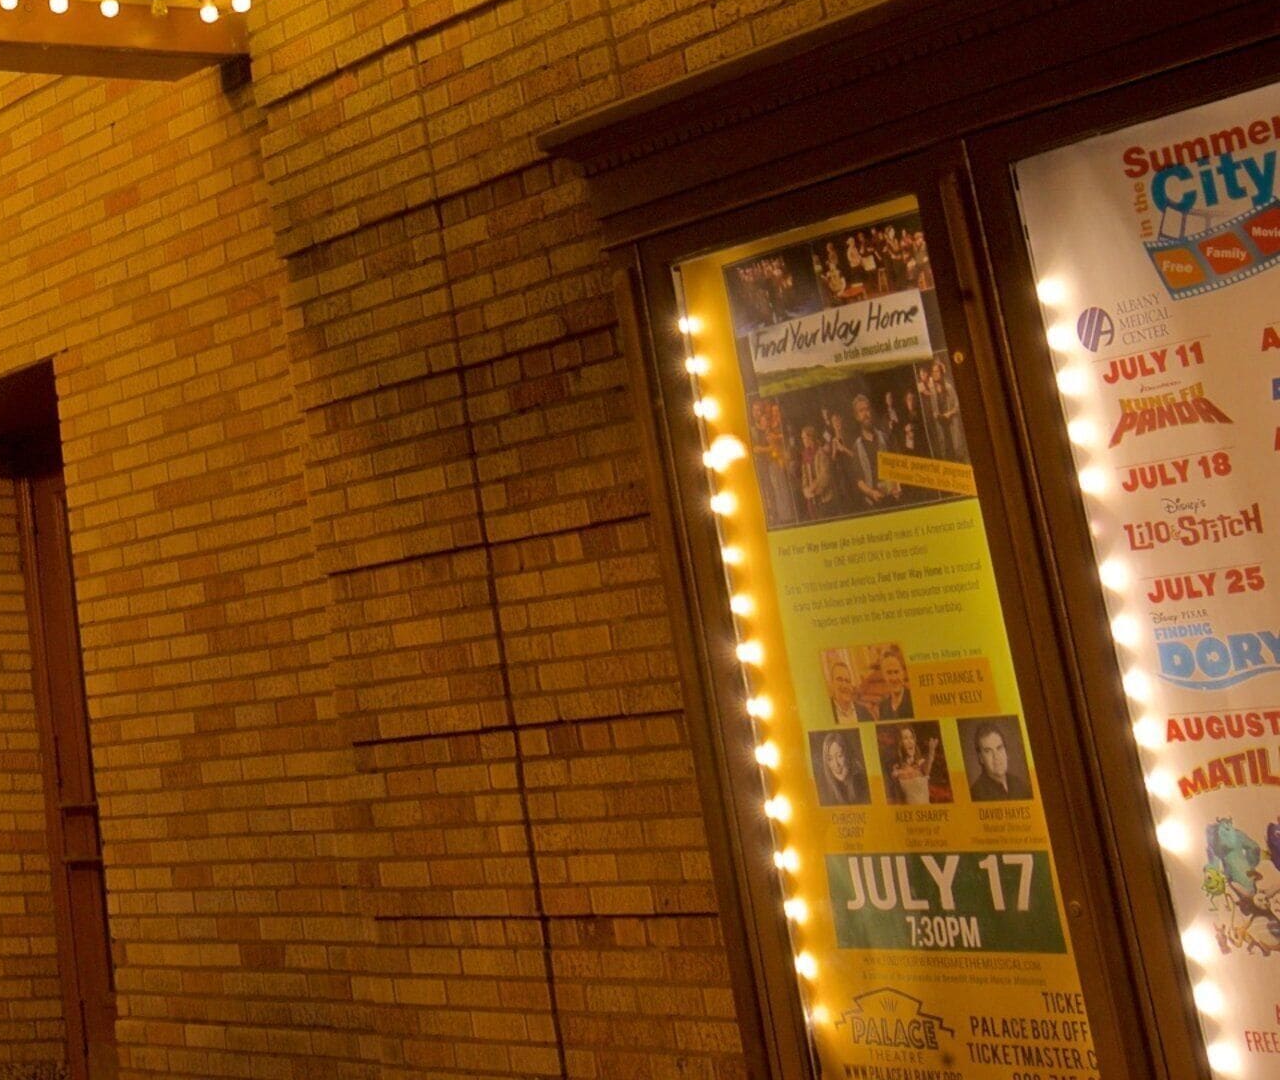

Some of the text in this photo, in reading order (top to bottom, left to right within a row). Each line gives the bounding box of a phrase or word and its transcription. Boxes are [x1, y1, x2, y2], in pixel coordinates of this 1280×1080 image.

[1151, 150, 1276, 212] City
[1134, 181, 1153, 238] in the
[1162, 259, 1194, 274] Free
[1206, 246, 1247, 262] Family
[1116, 293, 1161, 315] ALBANY
[754, 302, 919, 361] Find Your Way Home
[1119, 307, 1173, 331] MEDICAL
[844, 346, 860, 361] Irish
[861, 339, 892, 356] musical
[894, 335, 919, 350] drama
[1122, 324, 1170, 346] CENTER
[1102, 340, 1205, 384] JULY 11
[1119, 394, 1176, 413] KUNG
[1179, 381, 1205, 399] FU
[1108, 397, 1235, 449] PANDA
[1122, 451, 1233, 493] JULY 18
[1147, 566, 1266, 604] JULY 25
[1182, 608, 1209, 619] PIXAR
[1153, 622, 1214, 641] FINDING
[1157, 630, 1280, 679] DORY
[918, 672, 934, 688] JEFF
[936, 669, 976, 687] STRANGE
[929, 689, 983, 707] JIMMY KELLY
[1166, 710, 1280, 743] AUGUST
[1177, 746, 1280, 800] MATIL
[896, 808, 950, 823] ALEX SHARPE
[978, 806, 1031, 821] DAVID HAYES
[847, 854, 1034, 911] JULY 17
[905, 916, 982, 948] 7:30PM
[1041, 992, 1085, 1015] TICKE
[851, 1018, 939, 1050] PALACE
[969, 1015, 1089, 1042] PALACE BOX OFF
[1244, 1030, 1280, 1053] FREE
[868, 1048, 925, 1064] THEATRE
